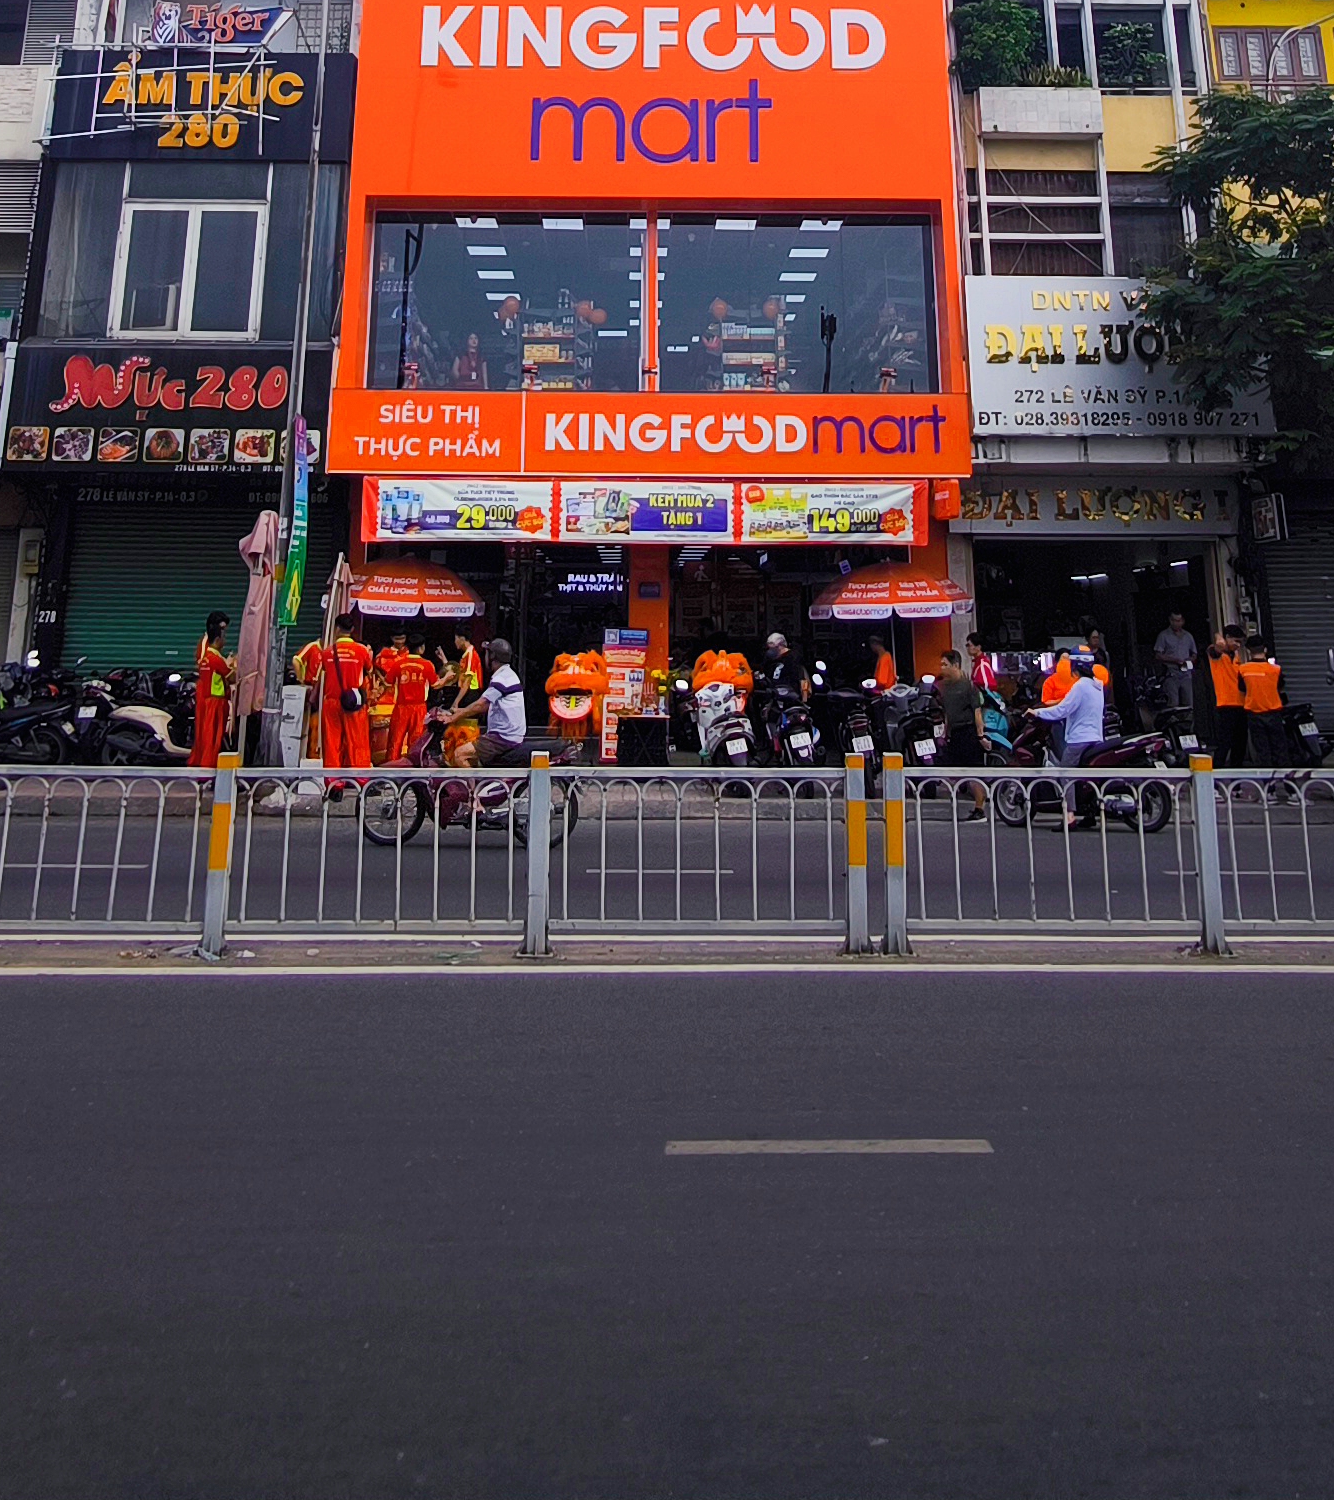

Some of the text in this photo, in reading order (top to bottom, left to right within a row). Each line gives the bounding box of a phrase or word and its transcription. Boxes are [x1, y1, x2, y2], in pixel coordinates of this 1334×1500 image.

[187, 4, 269, 42] Tiger
[420, 3, 886, 71] KINGFOOD
[187, 67, 305, 113] THỰC
[158, 113, 240, 148] 280
[530, 78, 772, 163] mart
[1032, 289, 1111, 311] DNTN
[984, 320, 1185, 374] ĐẠI LƯỢ
[190, 366, 288, 411] 280
[1014, 389, 1045, 404] 272
[1051, 385, 1074, 404] LÊ
[1081, 385, 1119, 404] VĂN
[1155, 389, 1187, 404] P.1
[378, 400, 480, 428] SIÊU THỊ
[978, 412, 1007, 426] ĐT:
[1147, 411, 1188, 427] 0918
[1194, 411, 1223, 427] 907
[1230, 411, 1260, 427] 271
[354, 430, 500, 460] THỰC PHẨM
[77, 487, 101, 502] 278
[649, 494, 715, 508] KEM MUA 2
[961, 488, 1041, 527] ĐẠI
[1053, 486, 1206, 528] LƯỢNG
[661, 508, 703, 529] TẶNG 1
